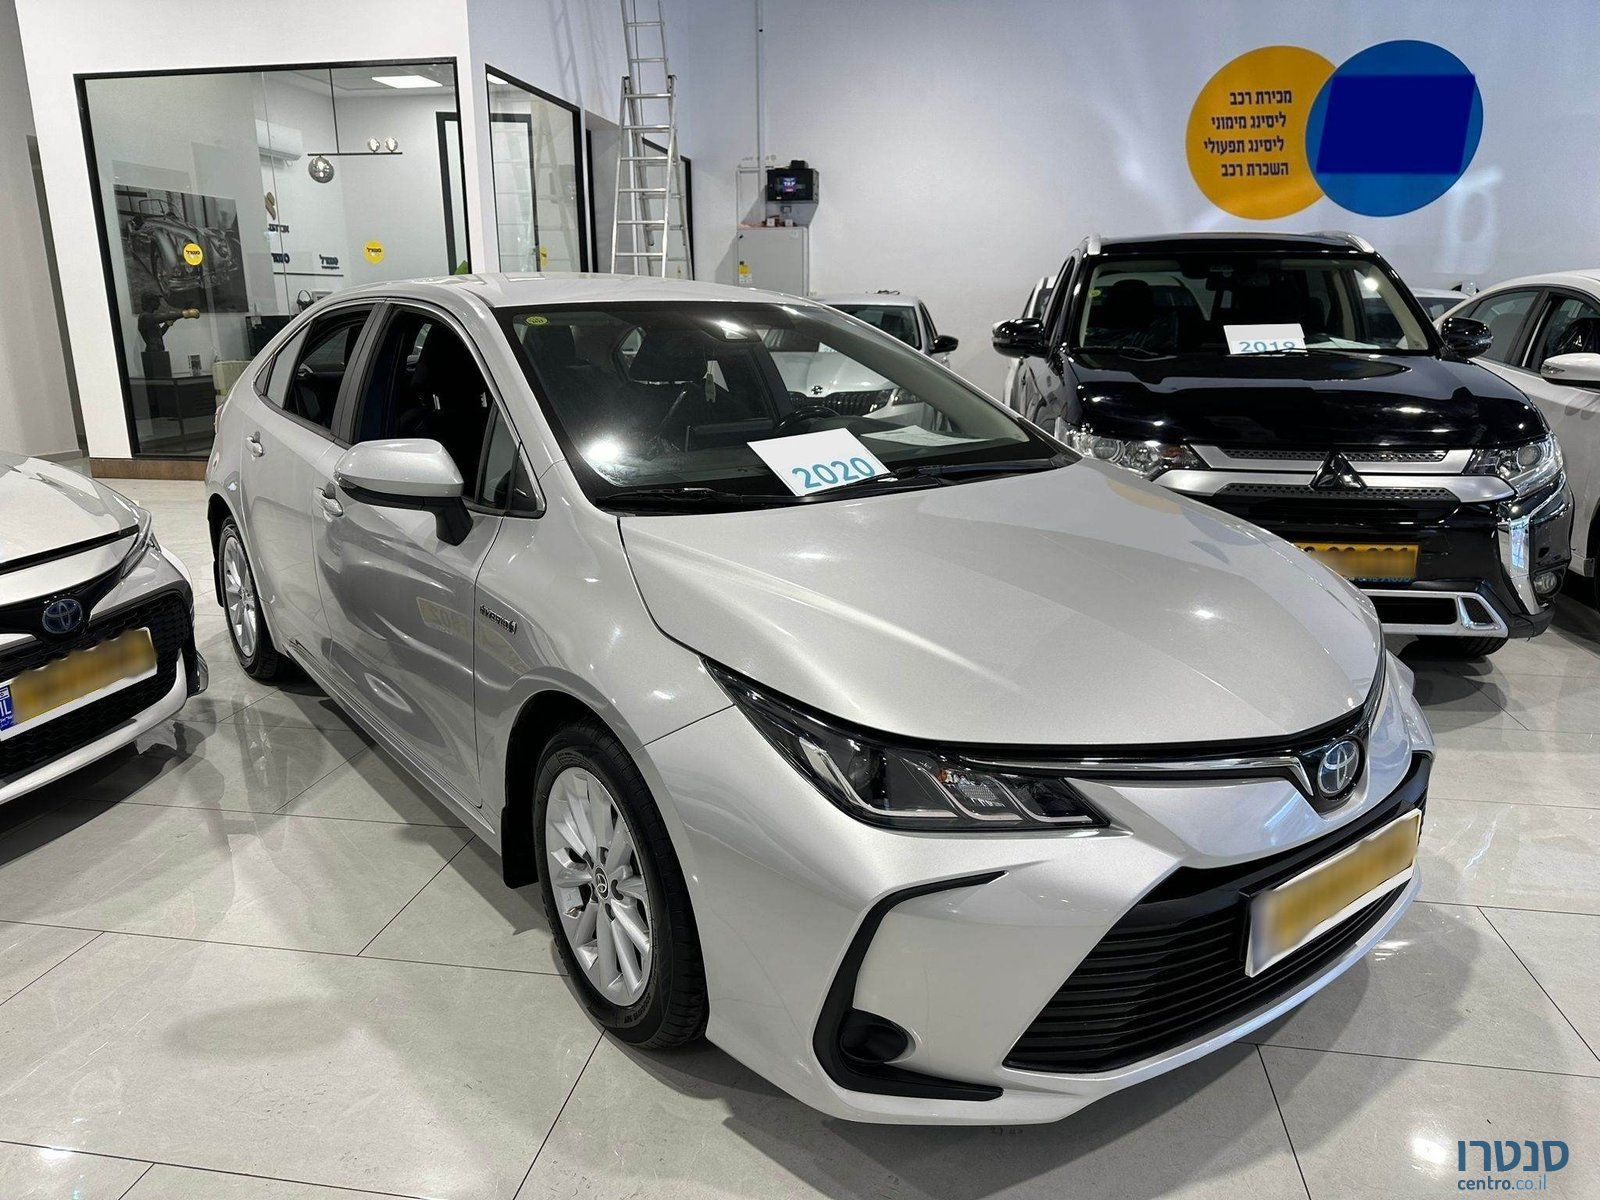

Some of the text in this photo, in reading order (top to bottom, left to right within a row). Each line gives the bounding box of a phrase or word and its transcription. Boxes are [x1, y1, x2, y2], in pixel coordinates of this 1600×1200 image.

[1229, 90, 1292, 105] מכירת רכב
[1211, 111, 1286, 130] ליסינג מימוני
[1203, 135, 1284, 156] ליסינג תפעולי
[1221, 162, 1289, 177] השכרת רכב
[792, 457, 876, 489] 2020
